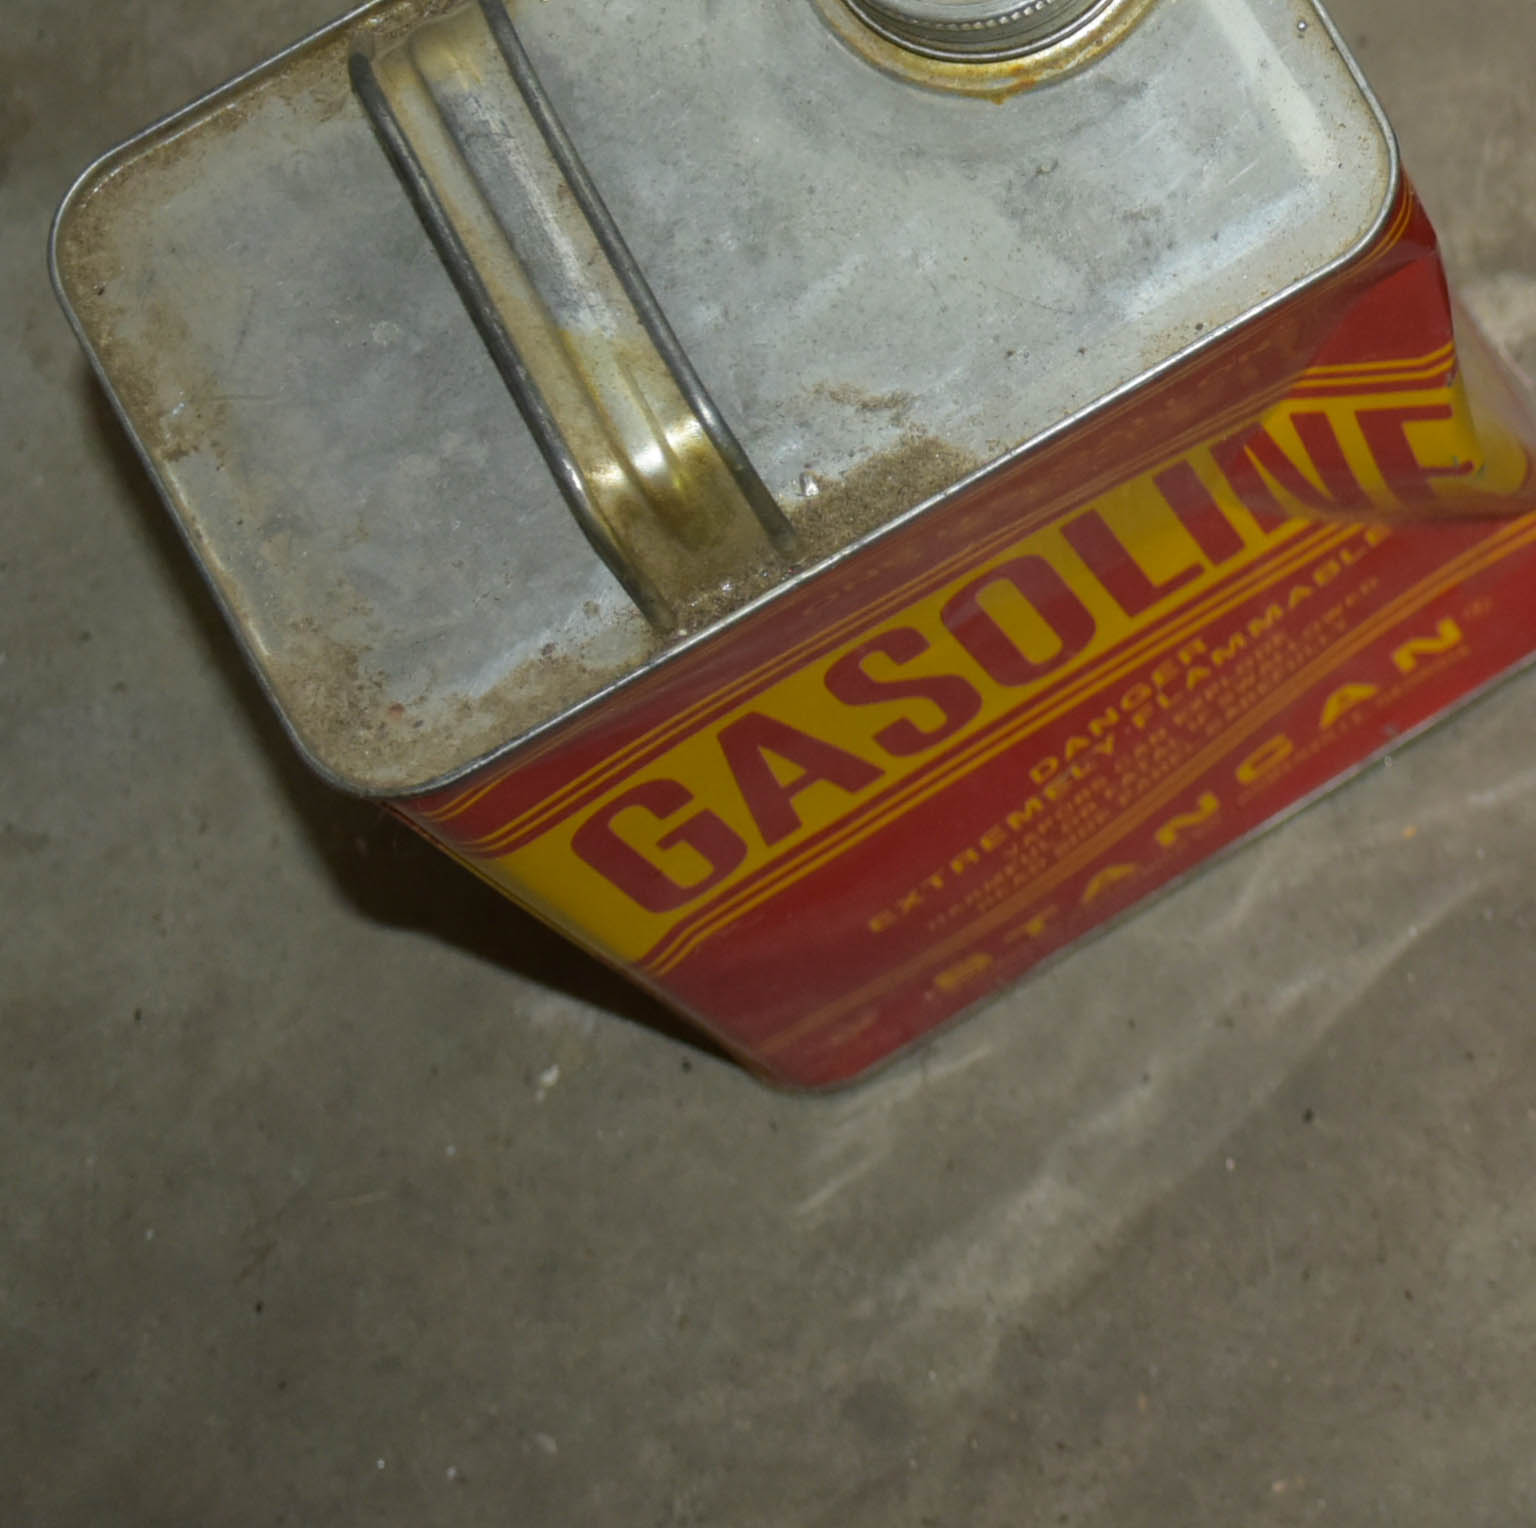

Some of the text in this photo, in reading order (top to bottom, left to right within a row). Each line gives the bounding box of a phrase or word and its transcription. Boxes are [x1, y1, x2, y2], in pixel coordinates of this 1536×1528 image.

[570, 403, 1476, 914] GASOLINE
[868, 732, 1116, 932] EXTREMELY
[1132, 522, 1393, 729] FLAMMABLE
[1029, 639, 1206, 784] DANGER
